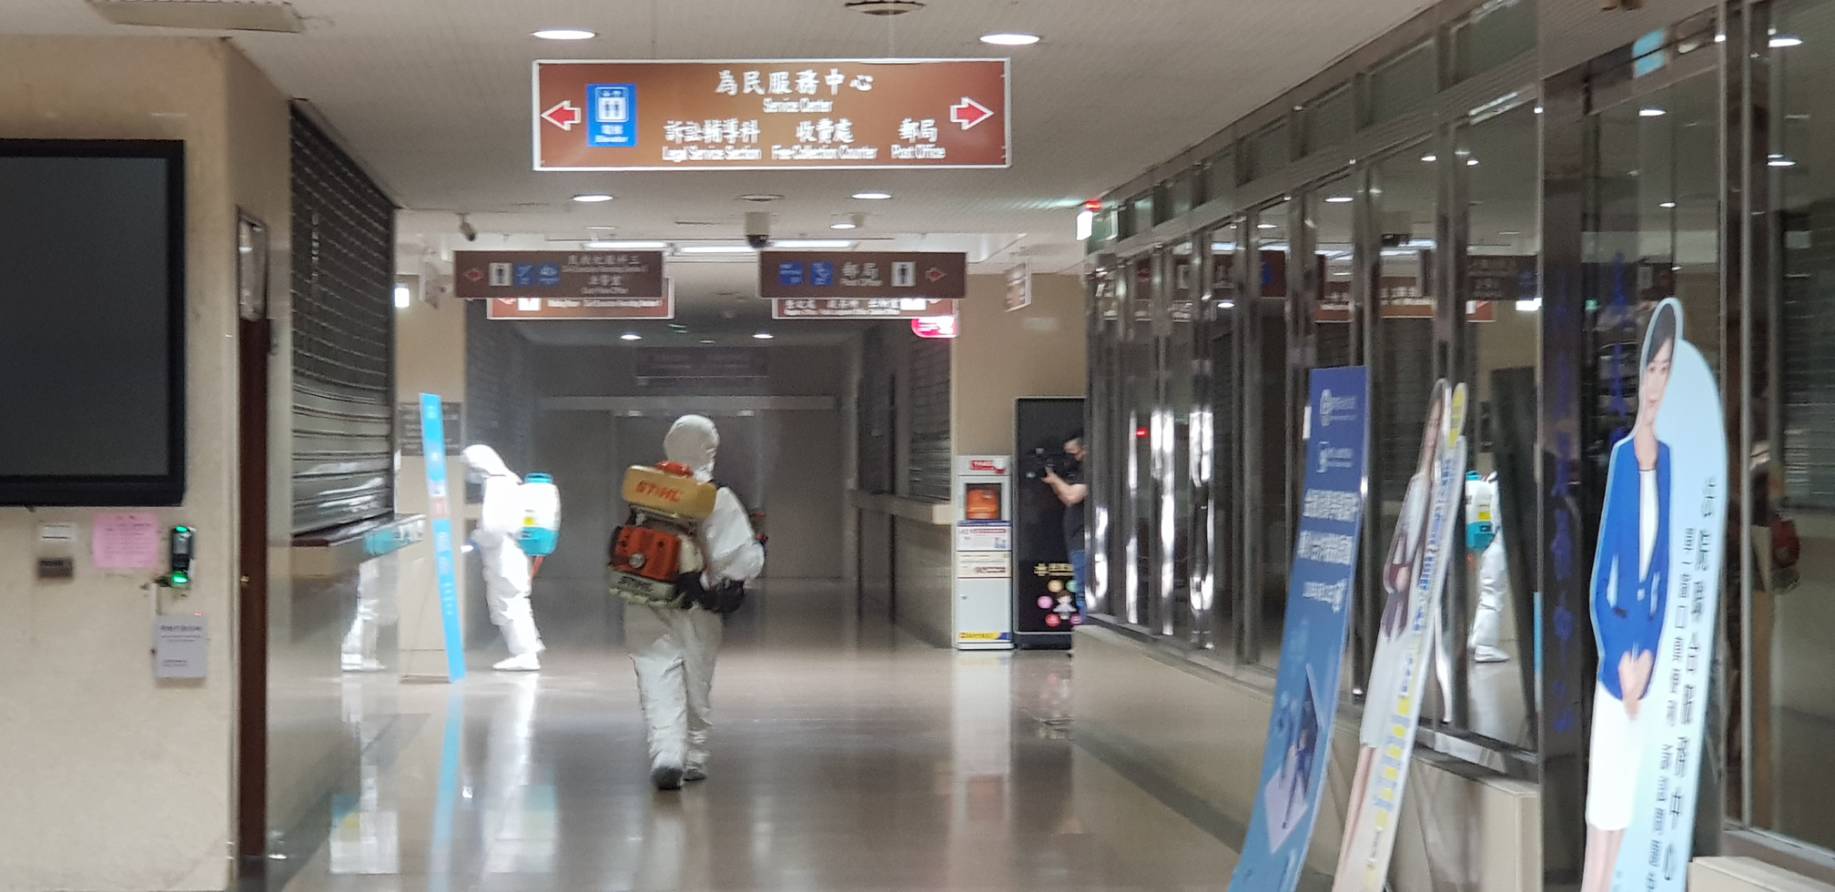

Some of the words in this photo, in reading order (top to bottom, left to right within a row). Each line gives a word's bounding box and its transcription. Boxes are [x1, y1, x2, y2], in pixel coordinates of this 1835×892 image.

[714, 68, 874, 95] 為民服務中心
[795, 118, 855, 143] 收費處
[898, 118, 938, 143] 郵局
[635, 480, 683, 503] STIHL
